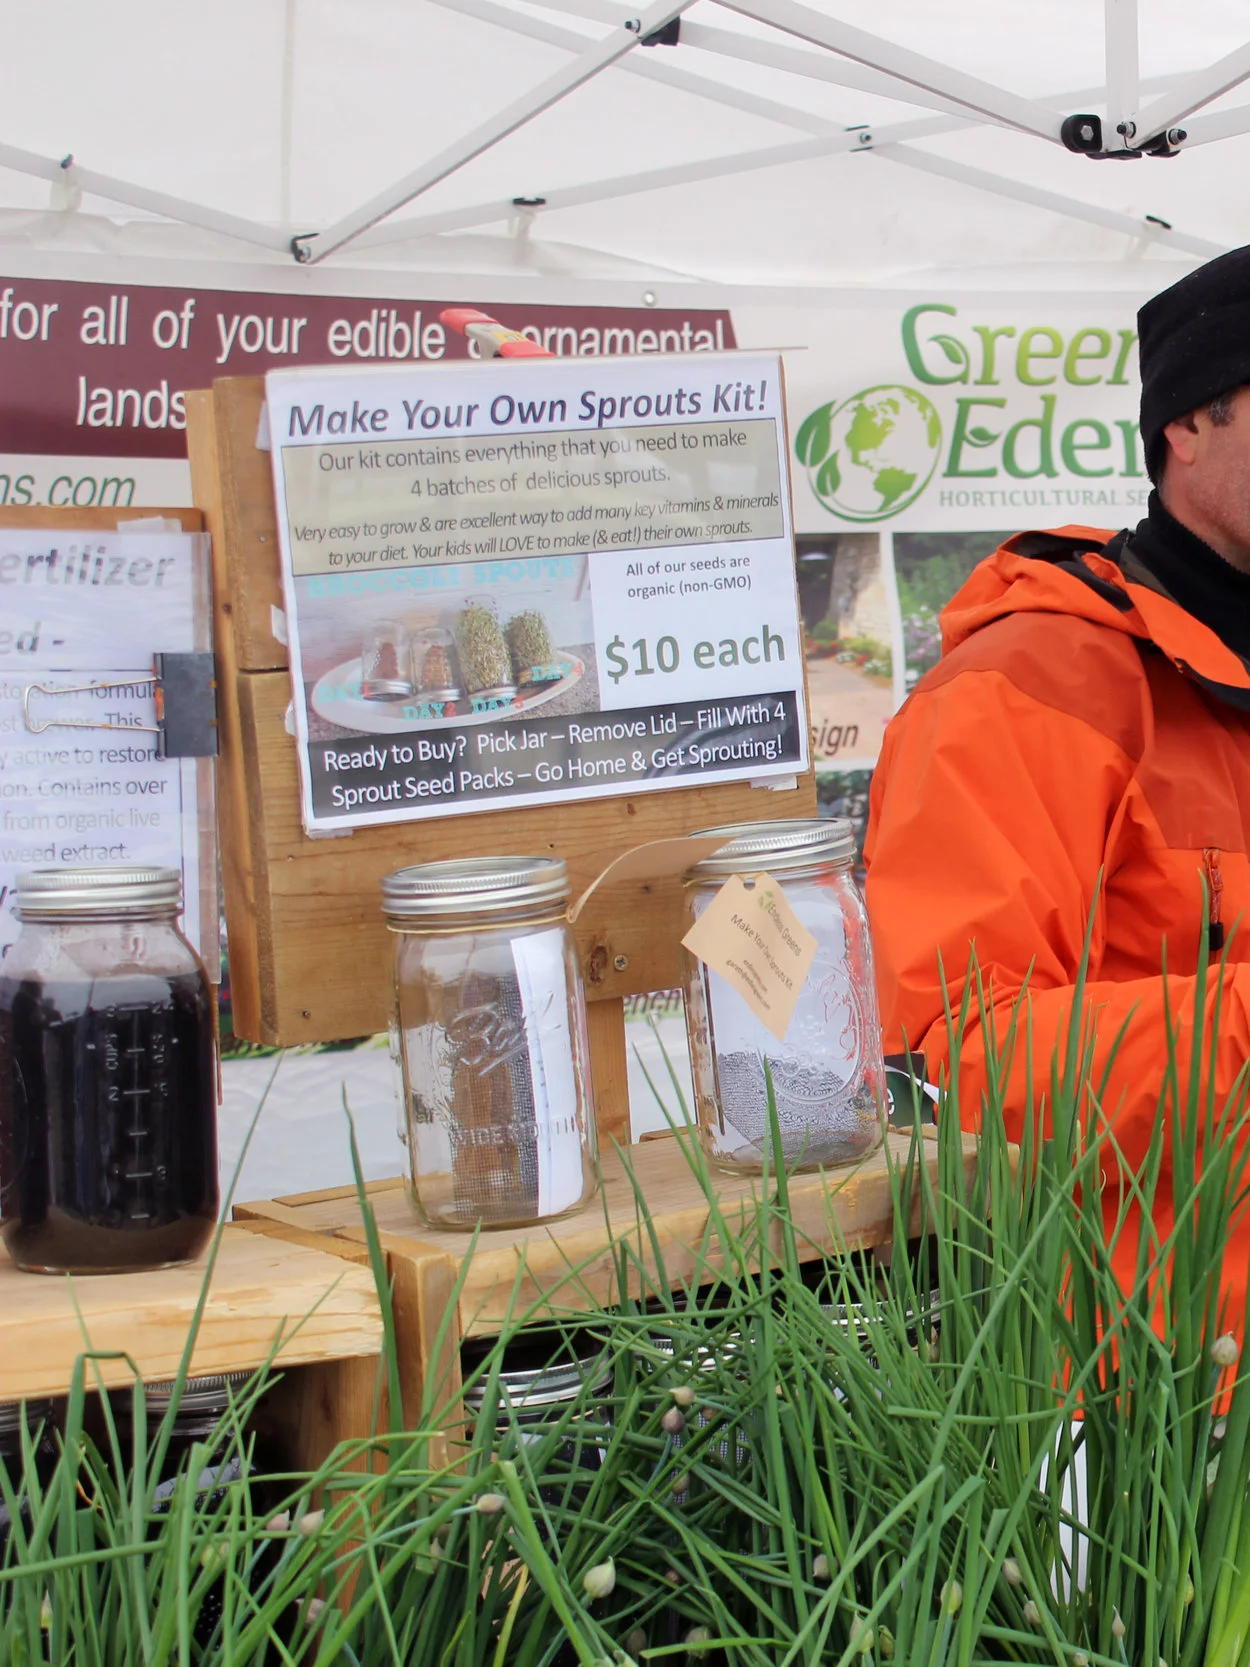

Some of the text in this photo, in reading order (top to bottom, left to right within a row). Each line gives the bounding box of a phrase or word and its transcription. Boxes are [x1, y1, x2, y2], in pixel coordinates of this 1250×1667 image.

[0, 288, 58, 341] for
[80, 295, 129, 346] all
[152, 299, 196, 350] of
[216, 312, 308, 363] your
[327, 309, 446, 360] edible
[289, 379, 768, 437] Make Your Own Sprouts Kit!
[319, 428, 748, 472] Our kit contains everything that you need to make
[410, 465, 671, 498] 4 batches of delicious sprouts.
[939, 488, 1120, 508] HORTICULTURAL
[295, 492, 779, 544] Very easy to grow & are excellent way to add many key vitamins & minerals
[329, 519, 753, 568] to your diet. Your kids will LOVE to make (& eat!) their own sprouts.
[626, 555, 751, 577] All of our seeds are
[308, 565, 460, 599] BROCCOLI
[627, 574, 752, 599] organic (non-GMO)
[605, 624, 786, 684] $10 each
[317, 682, 362, 702] DAY
[471, 696, 513, 714] DAY
[403, 702, 445, 721] DAY
[324, 701, 786, 772] Ready to Buy? Pick Jar Remove Lid Fill With 4
[14, 748, 70, 765] active
[74, 747, 95, 764] to
[332, 734, 784, 810] Sprout Seed Packs Go Home & Get Sprouting!
[38, 778, 122, 798] Contains
[126, 779, 168, 796] over
[4, 807, 161, 833] from organic live
[3, 842, 131, 864] weed extract.
[730, 913, 755, 939] Make
